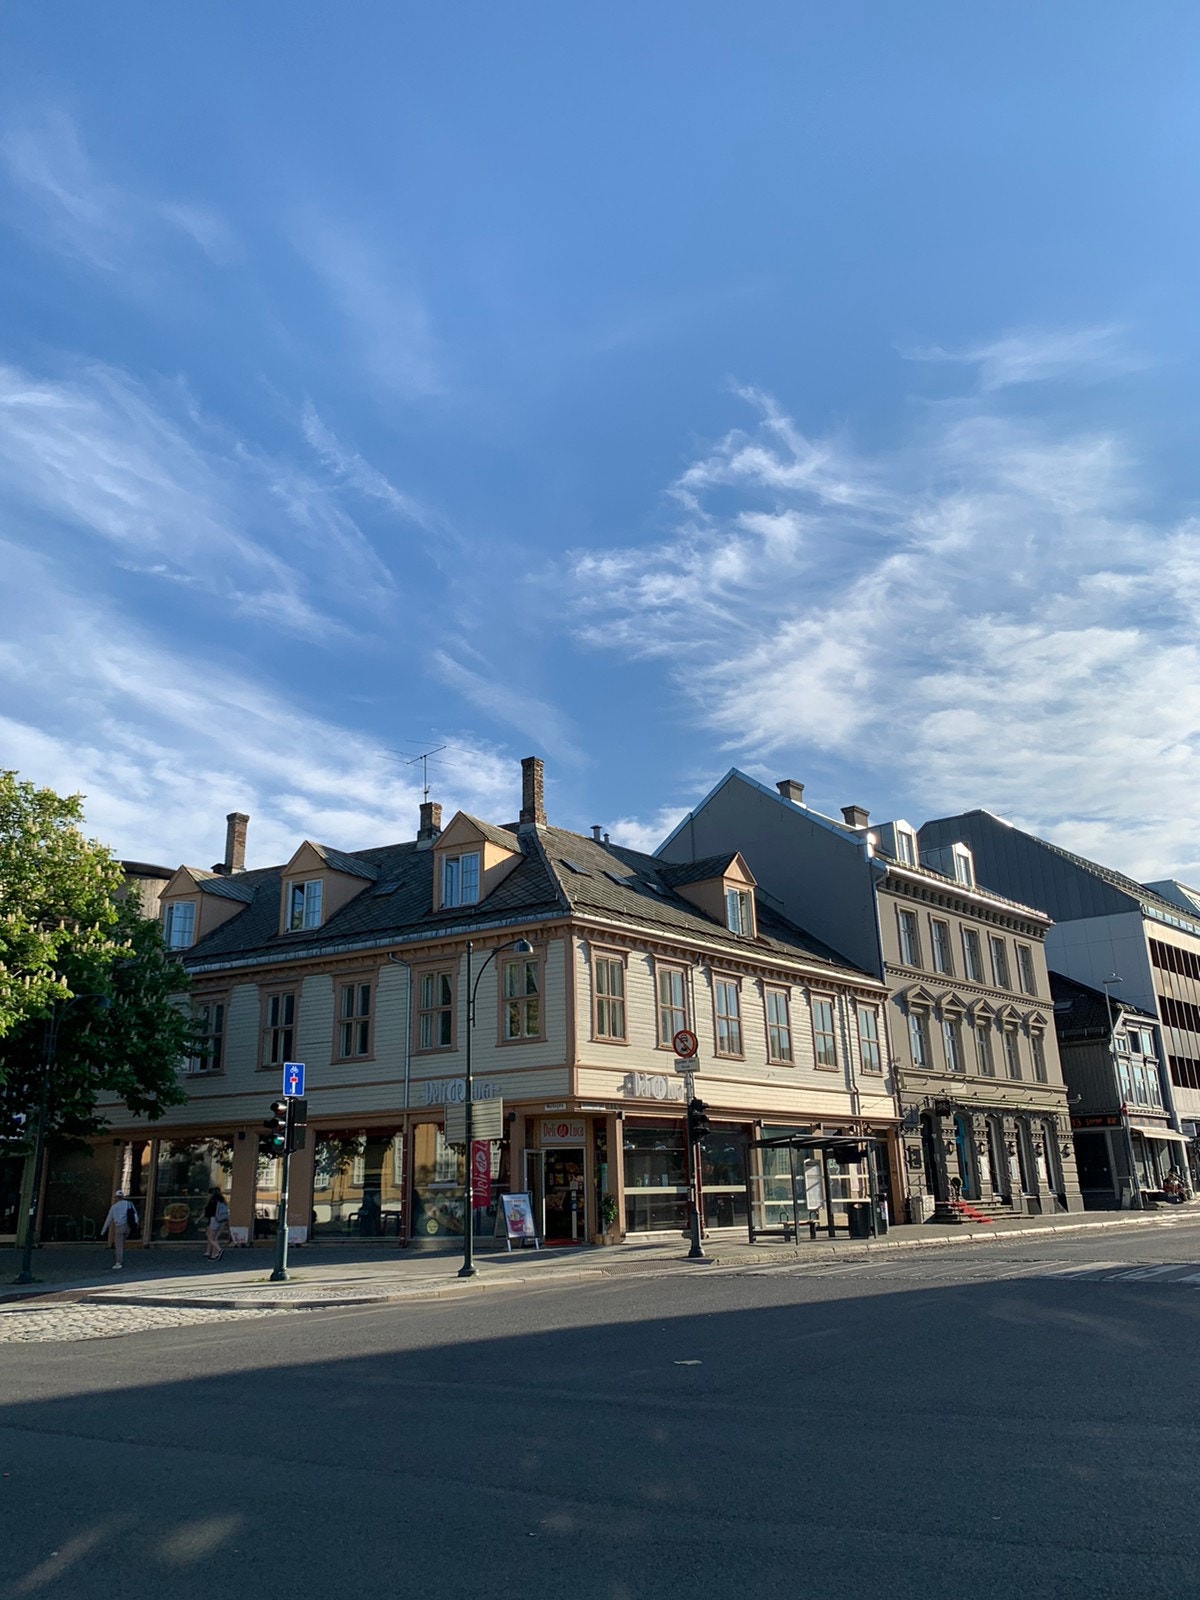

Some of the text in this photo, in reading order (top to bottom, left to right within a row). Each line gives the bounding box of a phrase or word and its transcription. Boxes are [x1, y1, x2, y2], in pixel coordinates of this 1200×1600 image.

[425, 1081, 447, 1104] Deli
[470, 1080, 495, 1100] uca
[634, 1072, 651, 1098] Deli
[543, 1123, 556, 1137] Deli
[570, 1123, 584, 1137] Luca
[473, 1174, 488, 1196] Deli
